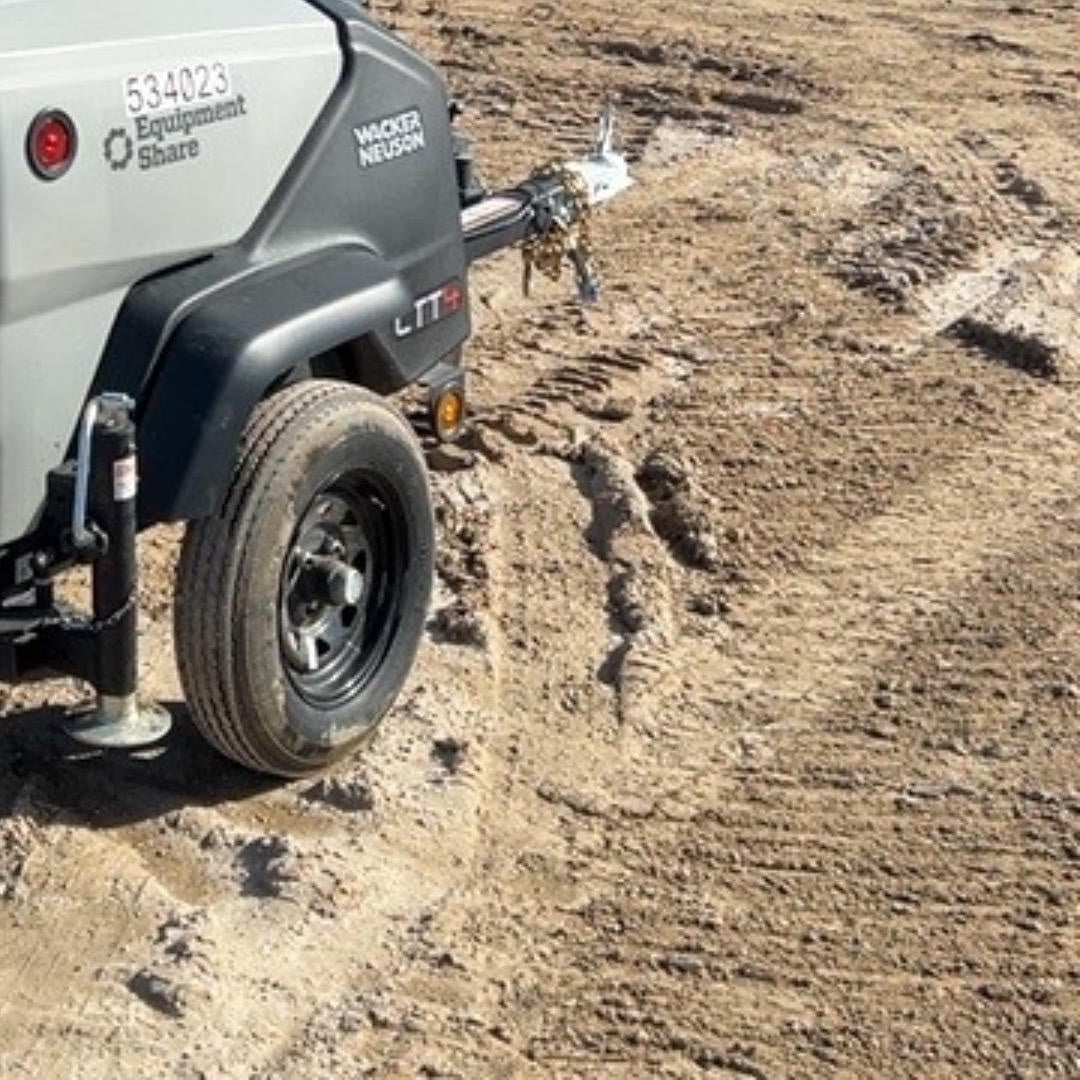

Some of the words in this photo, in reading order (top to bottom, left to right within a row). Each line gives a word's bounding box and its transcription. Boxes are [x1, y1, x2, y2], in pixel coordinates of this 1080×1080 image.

[126, 62, 230, 113] 534023
[134, 93, 247, 141] Equipment
[354, 110, 421, 145] WACKER
[138, 137, 199, 170] Share
[359, 132, 424, 167] NEUSON
